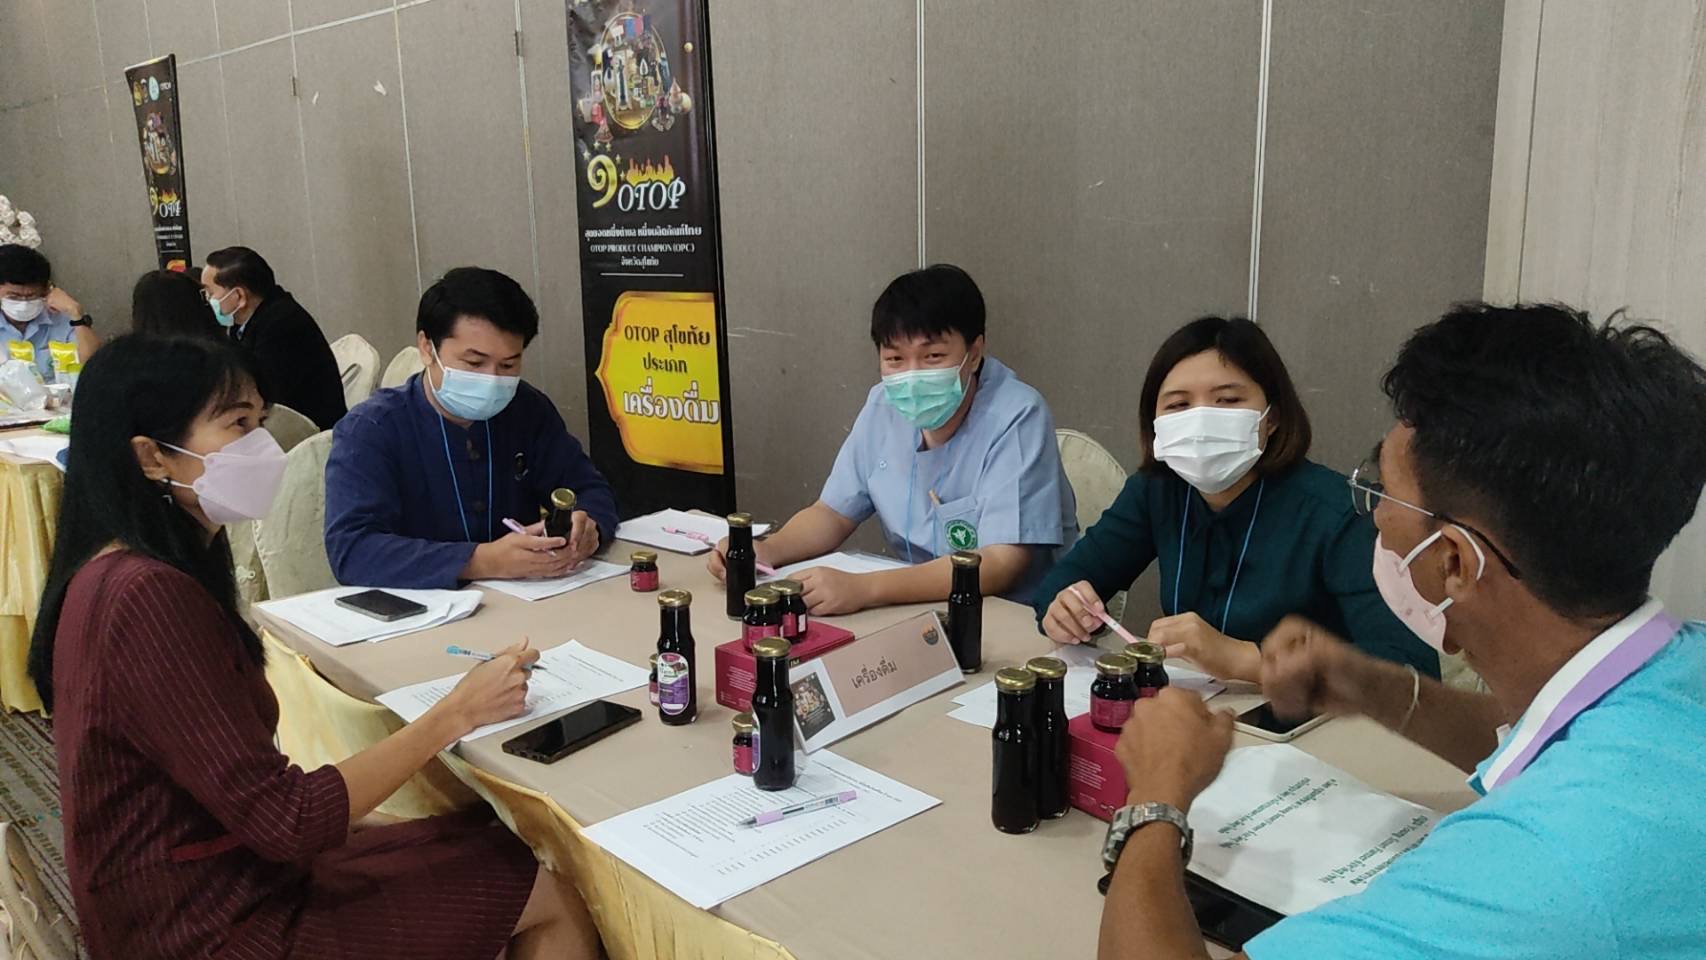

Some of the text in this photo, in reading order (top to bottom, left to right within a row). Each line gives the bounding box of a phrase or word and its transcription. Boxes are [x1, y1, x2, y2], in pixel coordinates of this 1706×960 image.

[618, 177, 686, 212] OTOP
[590, 243, 695, 252] OTOP PRODUCT CHAMPION (OPC)
[624, 324, 711, 351] OTOP สุโขทัย
[643, 352, 688, 373] ประเภท
[623, 377, 720, 424] เครื่องดื่ม
[851, 656, 898, 689] เครื่องดื่ม
